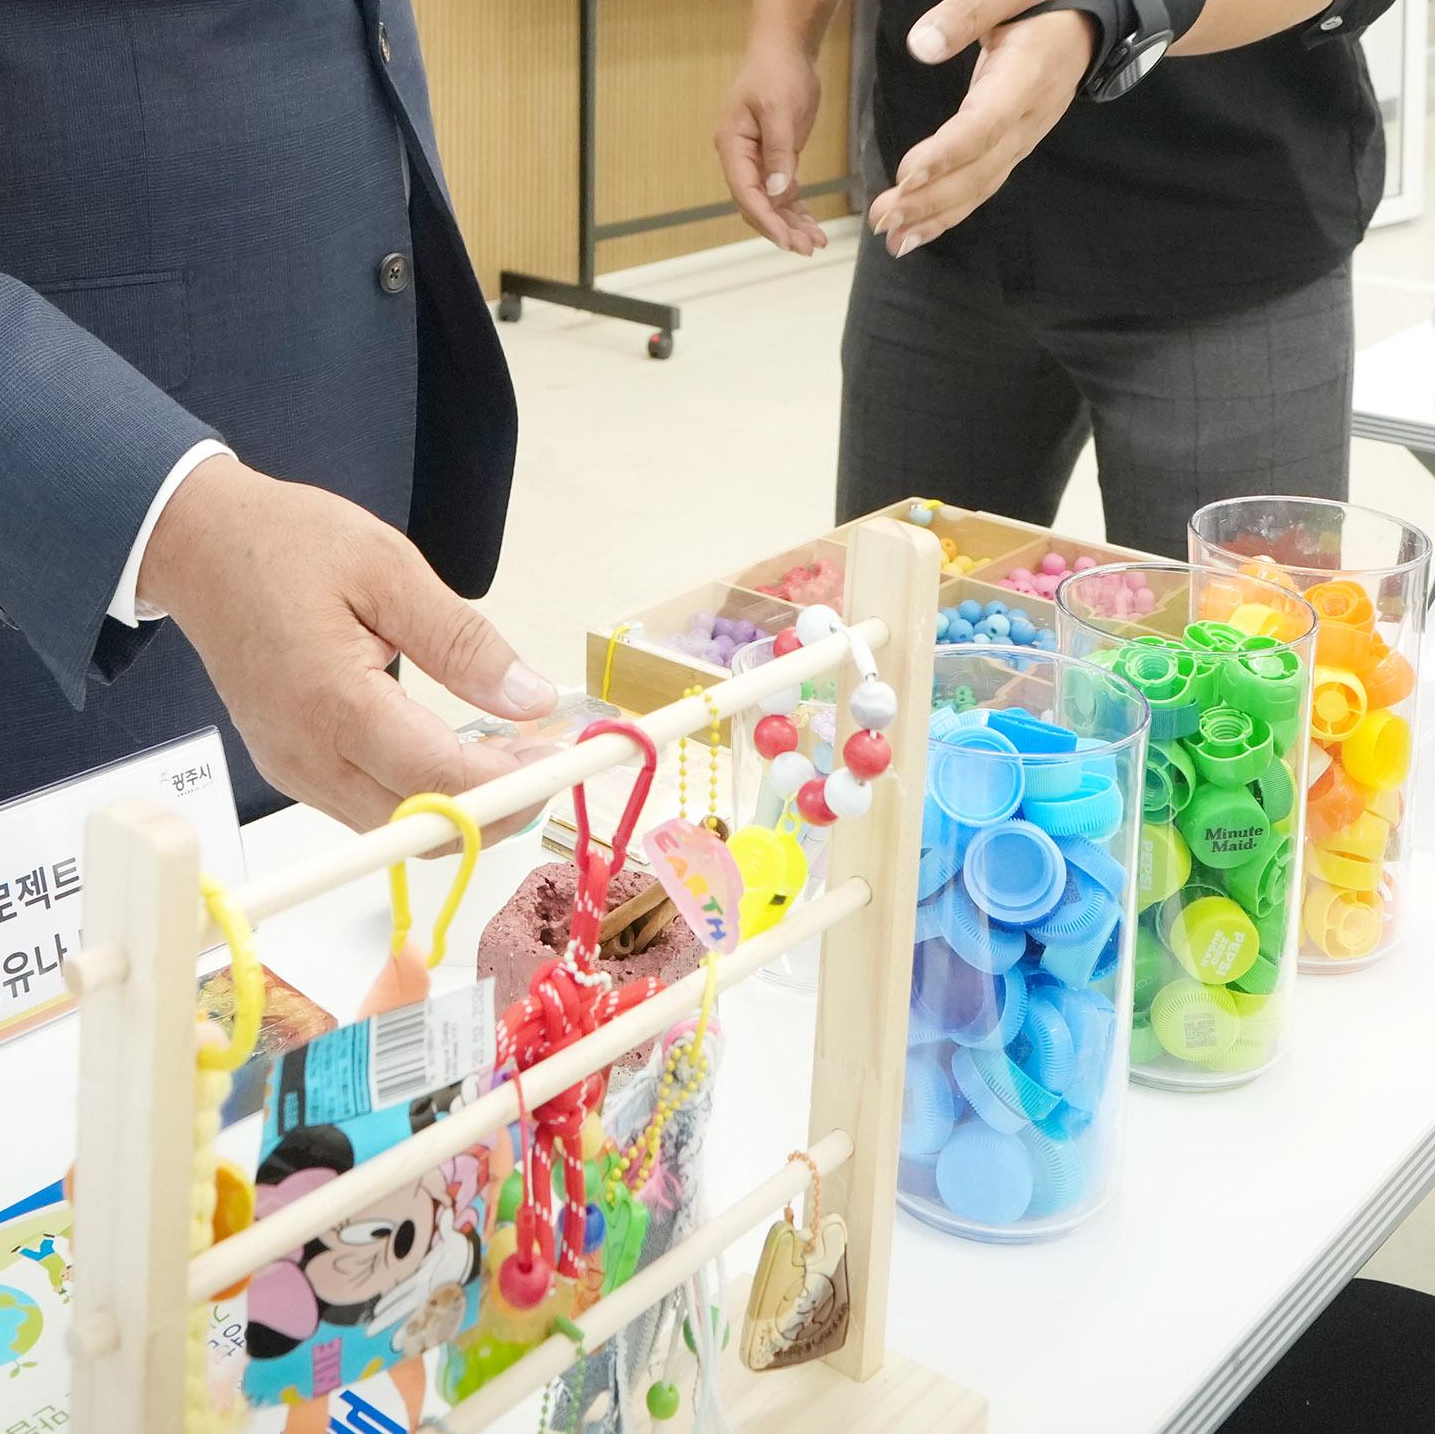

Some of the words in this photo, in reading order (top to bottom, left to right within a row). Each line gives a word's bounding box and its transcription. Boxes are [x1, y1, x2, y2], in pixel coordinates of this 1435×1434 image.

[171, 763, 212, 791] 광주시
[1205, 826, 1264, 841] Minute
[1140, 840, 1154, 891] PEPSI
[1216, 931, 1247, 976] PEPSI
